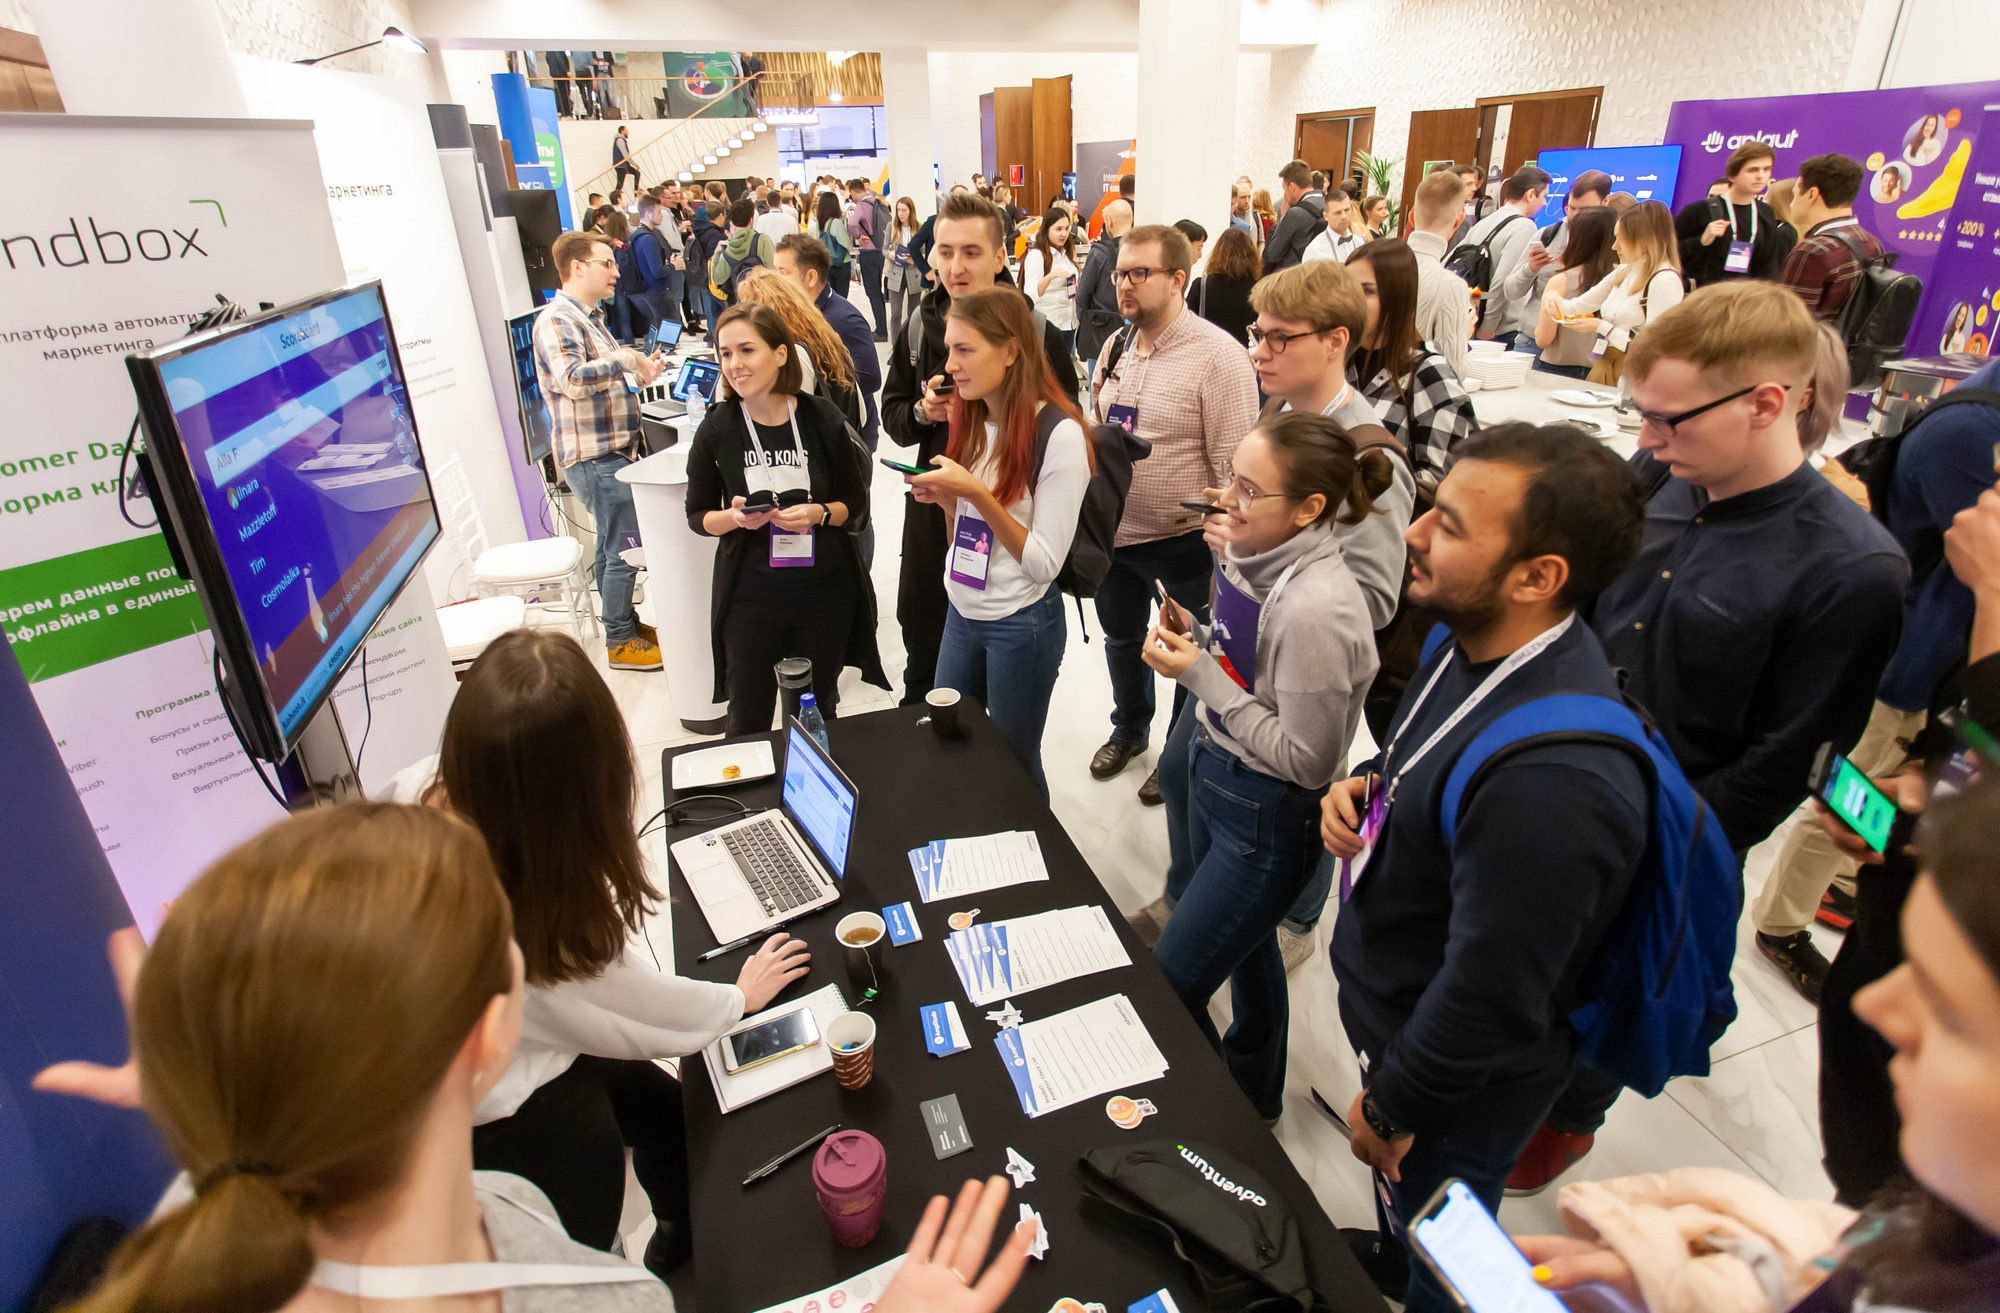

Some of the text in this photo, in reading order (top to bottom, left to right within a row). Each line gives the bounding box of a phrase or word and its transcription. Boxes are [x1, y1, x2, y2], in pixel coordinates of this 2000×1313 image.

[329, 184, 393, 199] аркетинга
[0, 216, 208, 269] ndbox
[1957, 220, 1985, 237] +200%
[280, 321, 321, 349] Scoreboard
[43, 338, 154, 361] маркетинга
[0, 450, 79, 479] omer
[0, 485, 82, 515] орма
[239, 502, 277, 542] Mazzletoff
[249, 556, 267, 576] Tim
[60, 574, 141, 608] данные
[106, 604, 119, 616] в
[124, 579, 197, 610] единый
[261, 565, 300, 608] Cosmolalka
[398, 614, 422, 630] сайта
[135, 689, 211, 720] Программа
[370, 687, 403, 703] Pop-ups
[150, 724, 191, 745] Бонусы
[193, 720, 200, 730] и
[176, 738, 211, 757] Призы
[213, 734, 220, 744] и
[171, 751, 235, 781] Визуальный
[193, 766, 255, 794] Виртуальны
